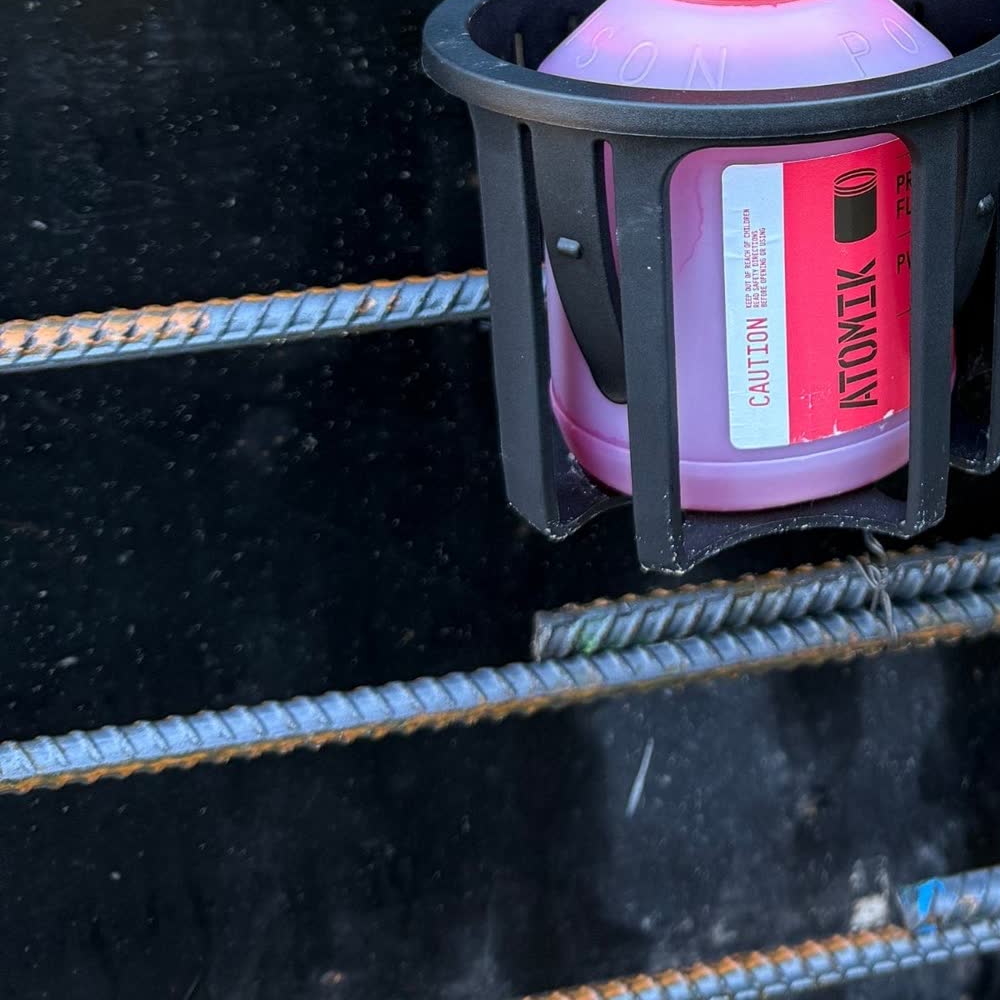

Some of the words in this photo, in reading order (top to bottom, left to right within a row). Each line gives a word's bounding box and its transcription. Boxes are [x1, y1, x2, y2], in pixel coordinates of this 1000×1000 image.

[751, 230, 759, 267] DIRECTIONS
[746, 317, 771, 408] CAUTION
[836, 257, 878, 409] ATOMIK
